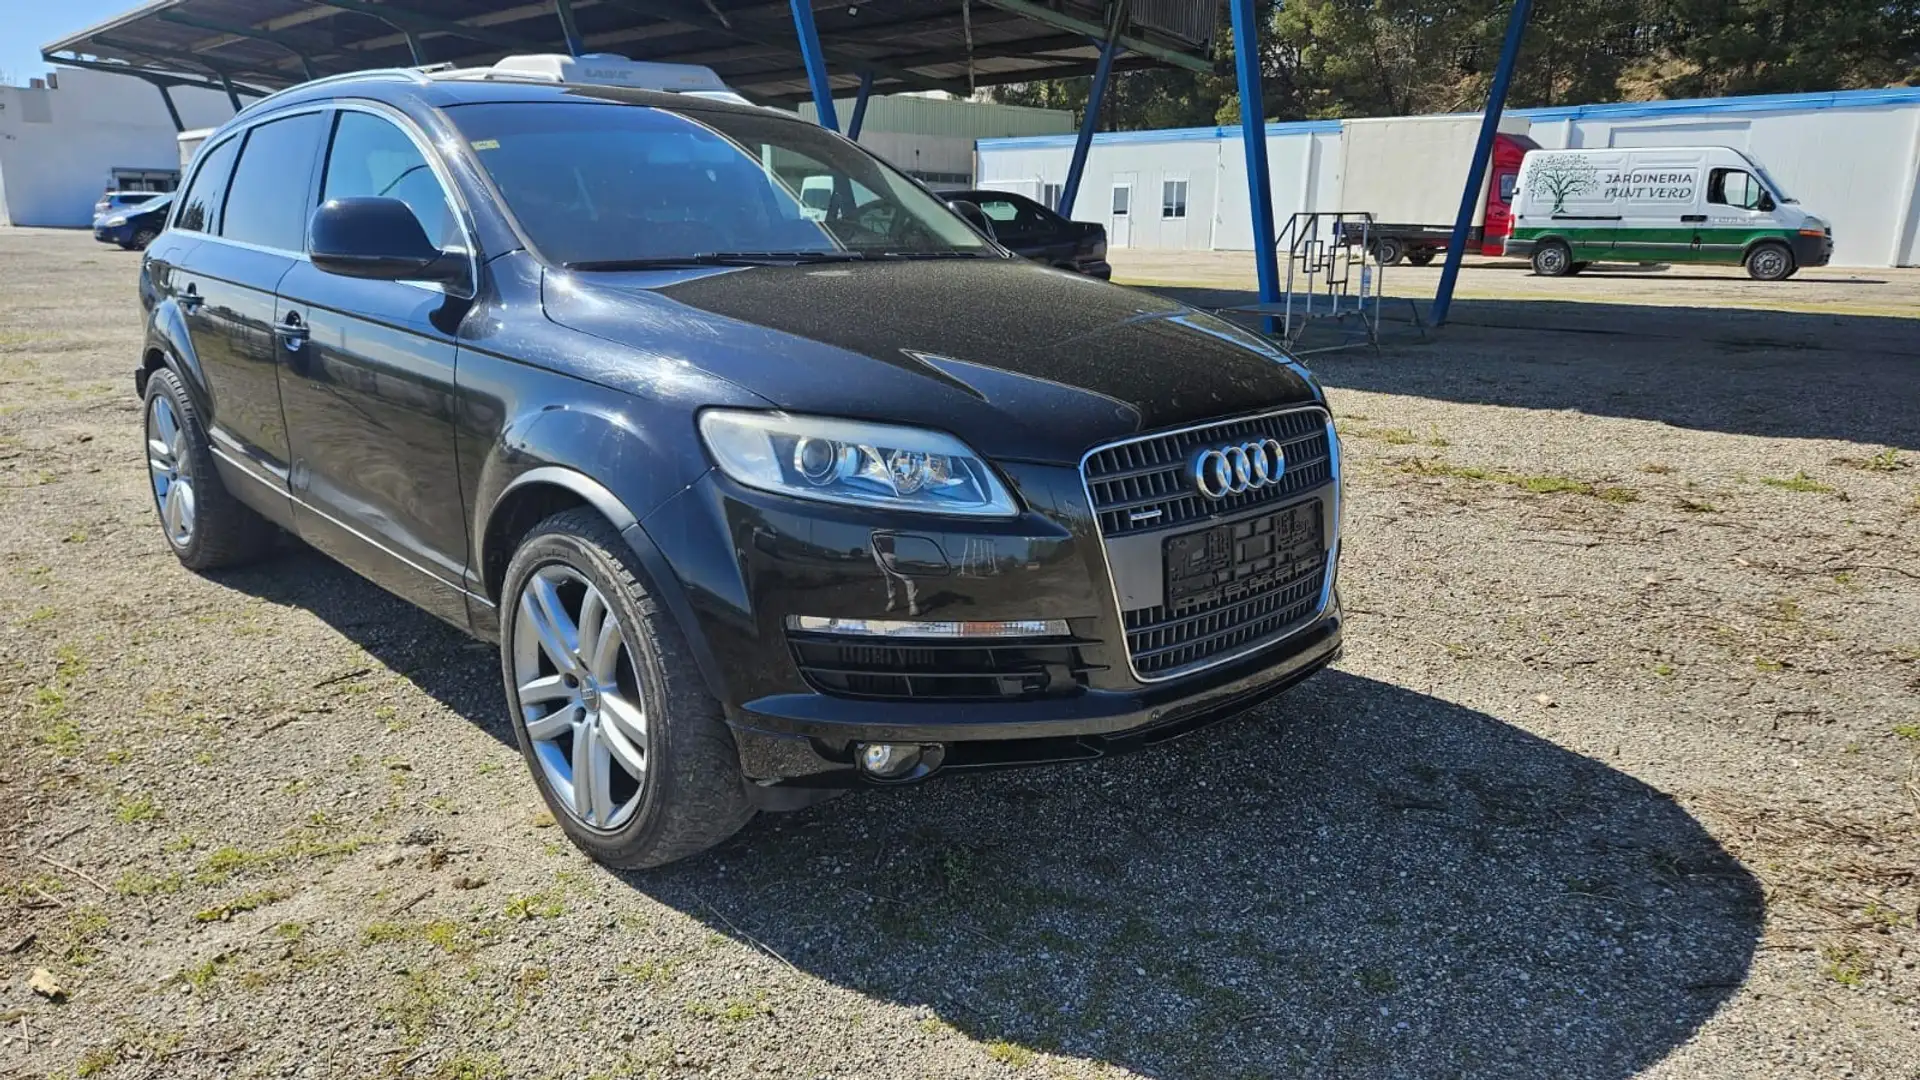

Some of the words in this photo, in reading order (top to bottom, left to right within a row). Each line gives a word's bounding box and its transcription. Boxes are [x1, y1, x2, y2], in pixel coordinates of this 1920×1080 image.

[1605, 174, 1692, 184] JARDINERIA
[1604, 187, 1645, 198] PUNT
[1649, 187, 1692, 198] VERD
